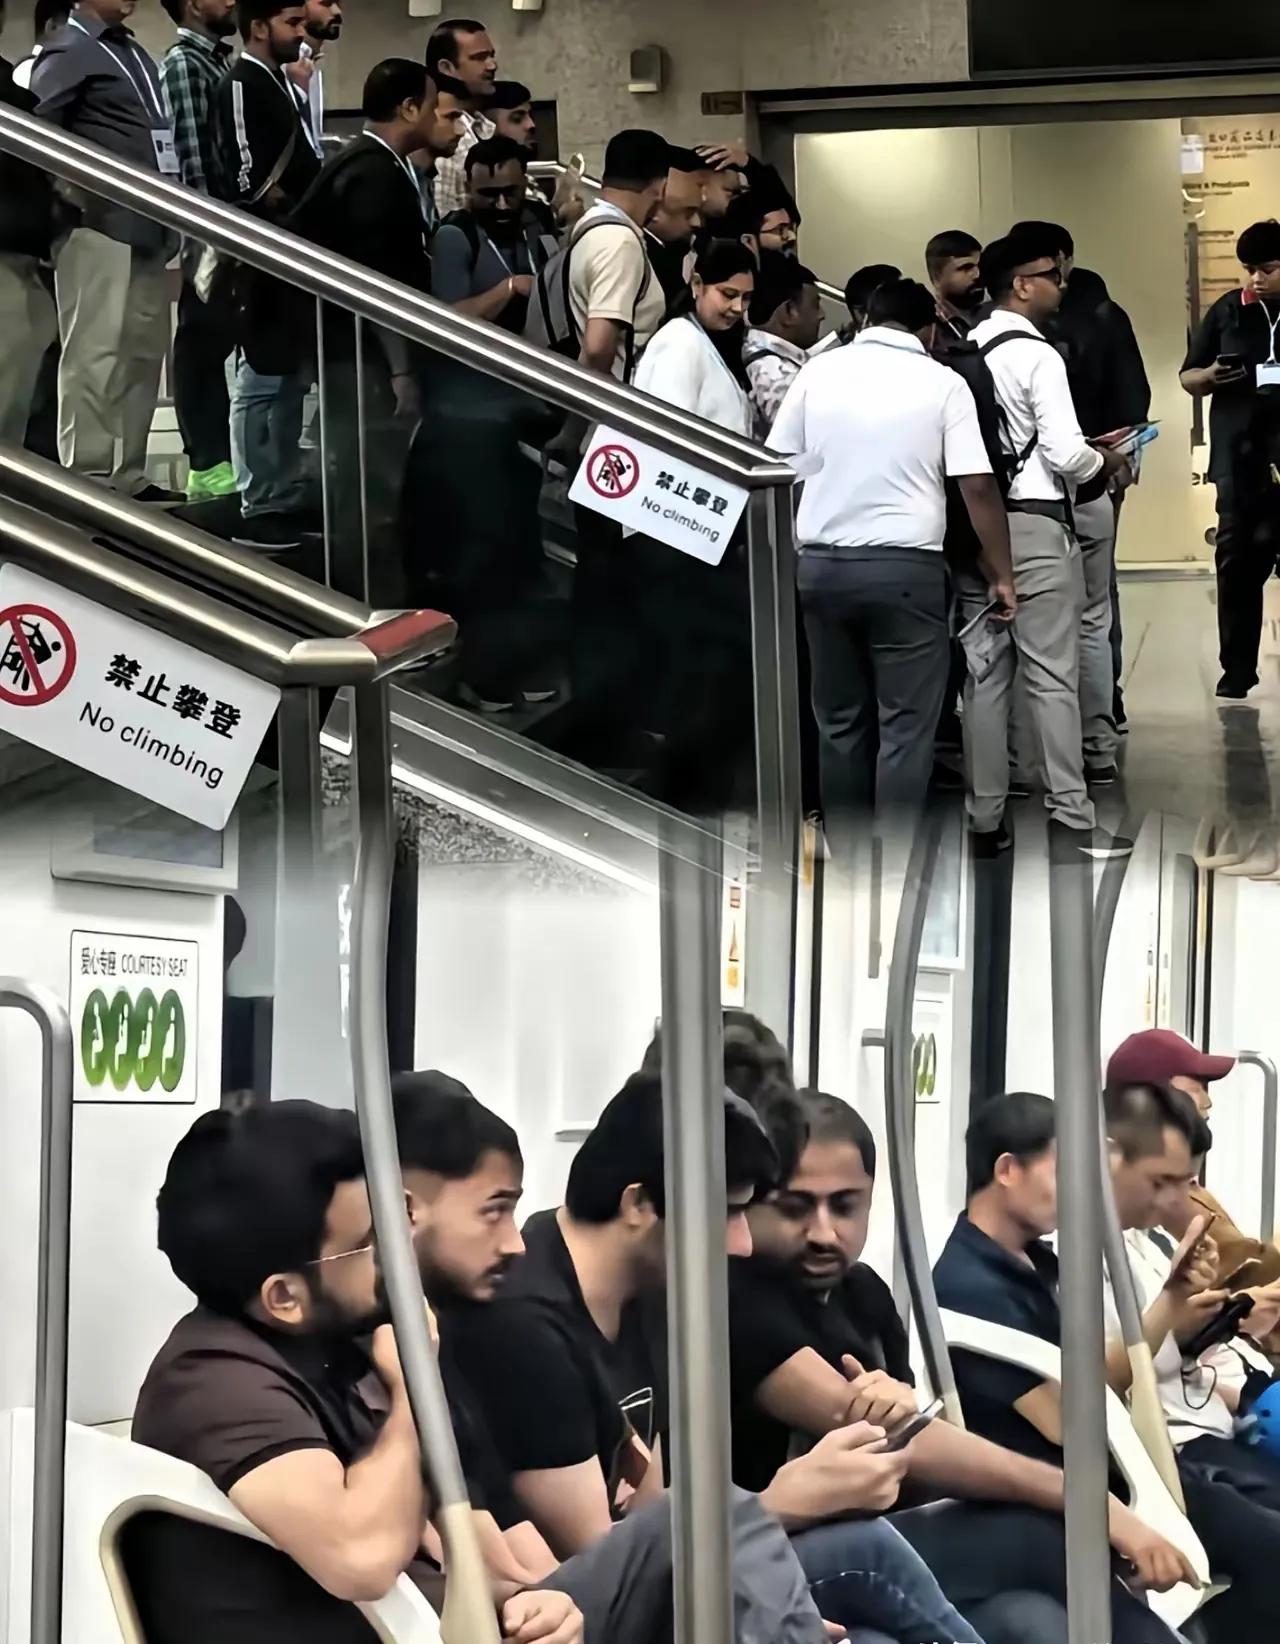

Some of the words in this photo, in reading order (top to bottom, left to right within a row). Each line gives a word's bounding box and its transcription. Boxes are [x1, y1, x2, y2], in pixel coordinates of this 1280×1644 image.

[655, 471, 728, 516] 禁止攀登
[641, 496, 661, 514] No
[663, 508, 720, 543] climbing
[104, 653, 241, 739] 禁止攀登
[79, 701, 115, 733] No
[120, 726, 224, 789] climbing
[80, 947, 117, 976] 爱心专座
[121, 953, 167, 977] COURTESY
[169, 957, 188, 977] SEAT
